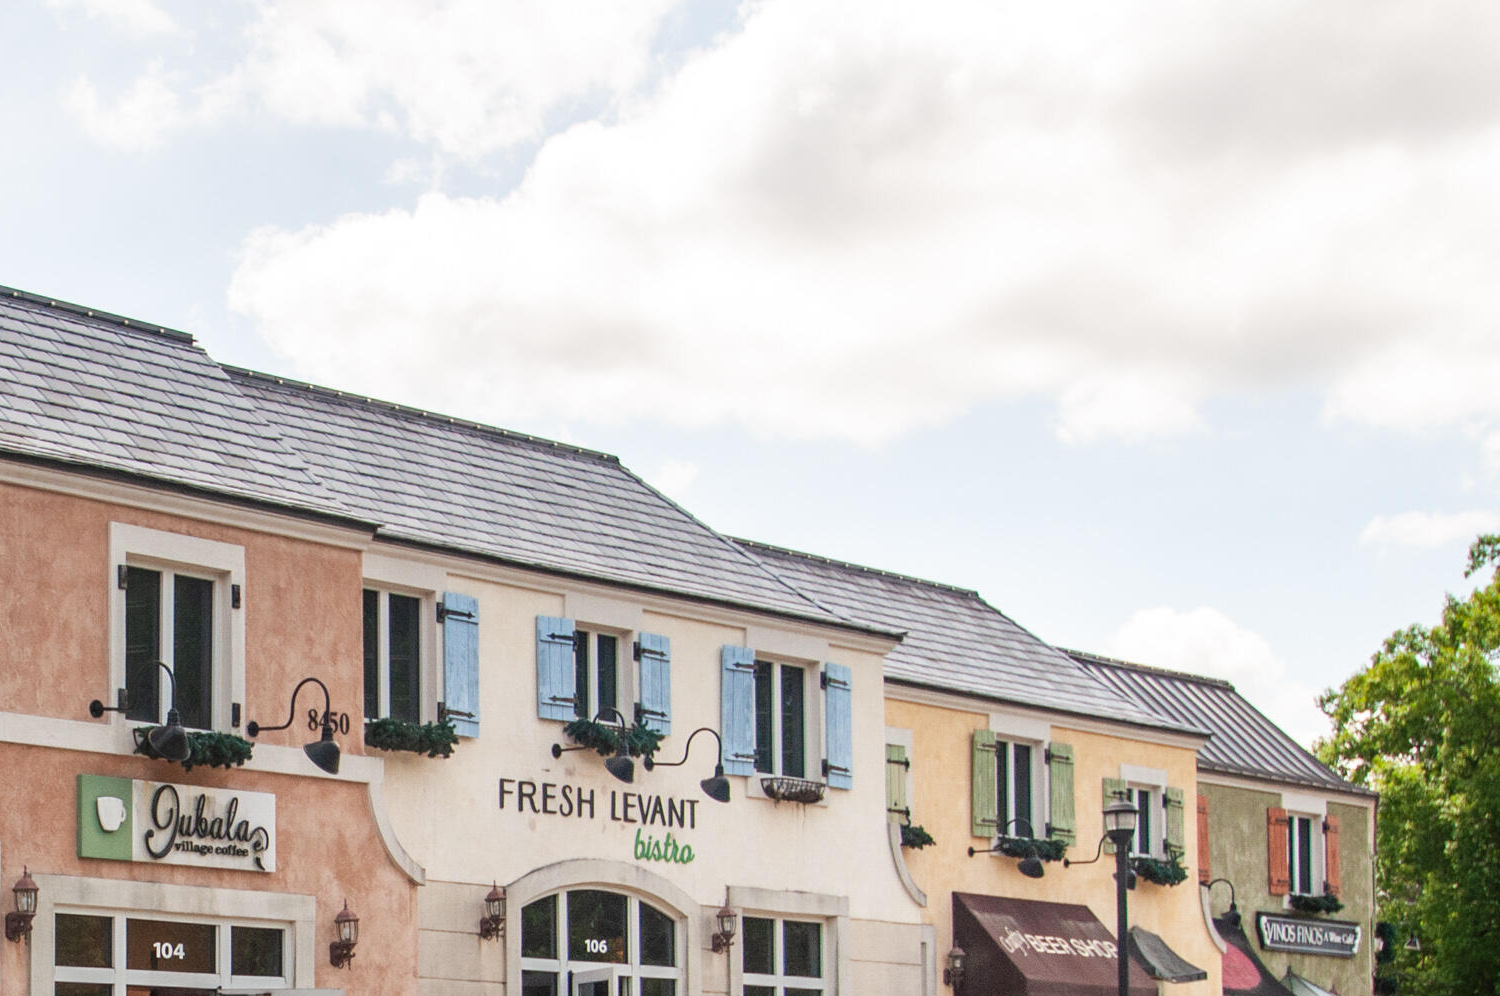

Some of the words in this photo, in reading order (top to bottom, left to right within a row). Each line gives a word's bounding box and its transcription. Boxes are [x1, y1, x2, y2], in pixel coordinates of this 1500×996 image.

[499, 778, 595, 819] FRESH
[611, 791, 699, 829] LEVANT
[145, 784, 269, 859] Jubala
[174, 840, 214, 856] village
[215, 844, 249, 857] coffee
[633, 827, 695, 864] bistro
[1265, 922, 1296, 943] VINOS
[1297, 926, 1324, 945] FINOS
[153, 942, 185, 960] 104
[584, 939, 608, 953] 106
[1024, 933, 1077, 956] BEER
[1069, 937, 1118, 959] SHOP
